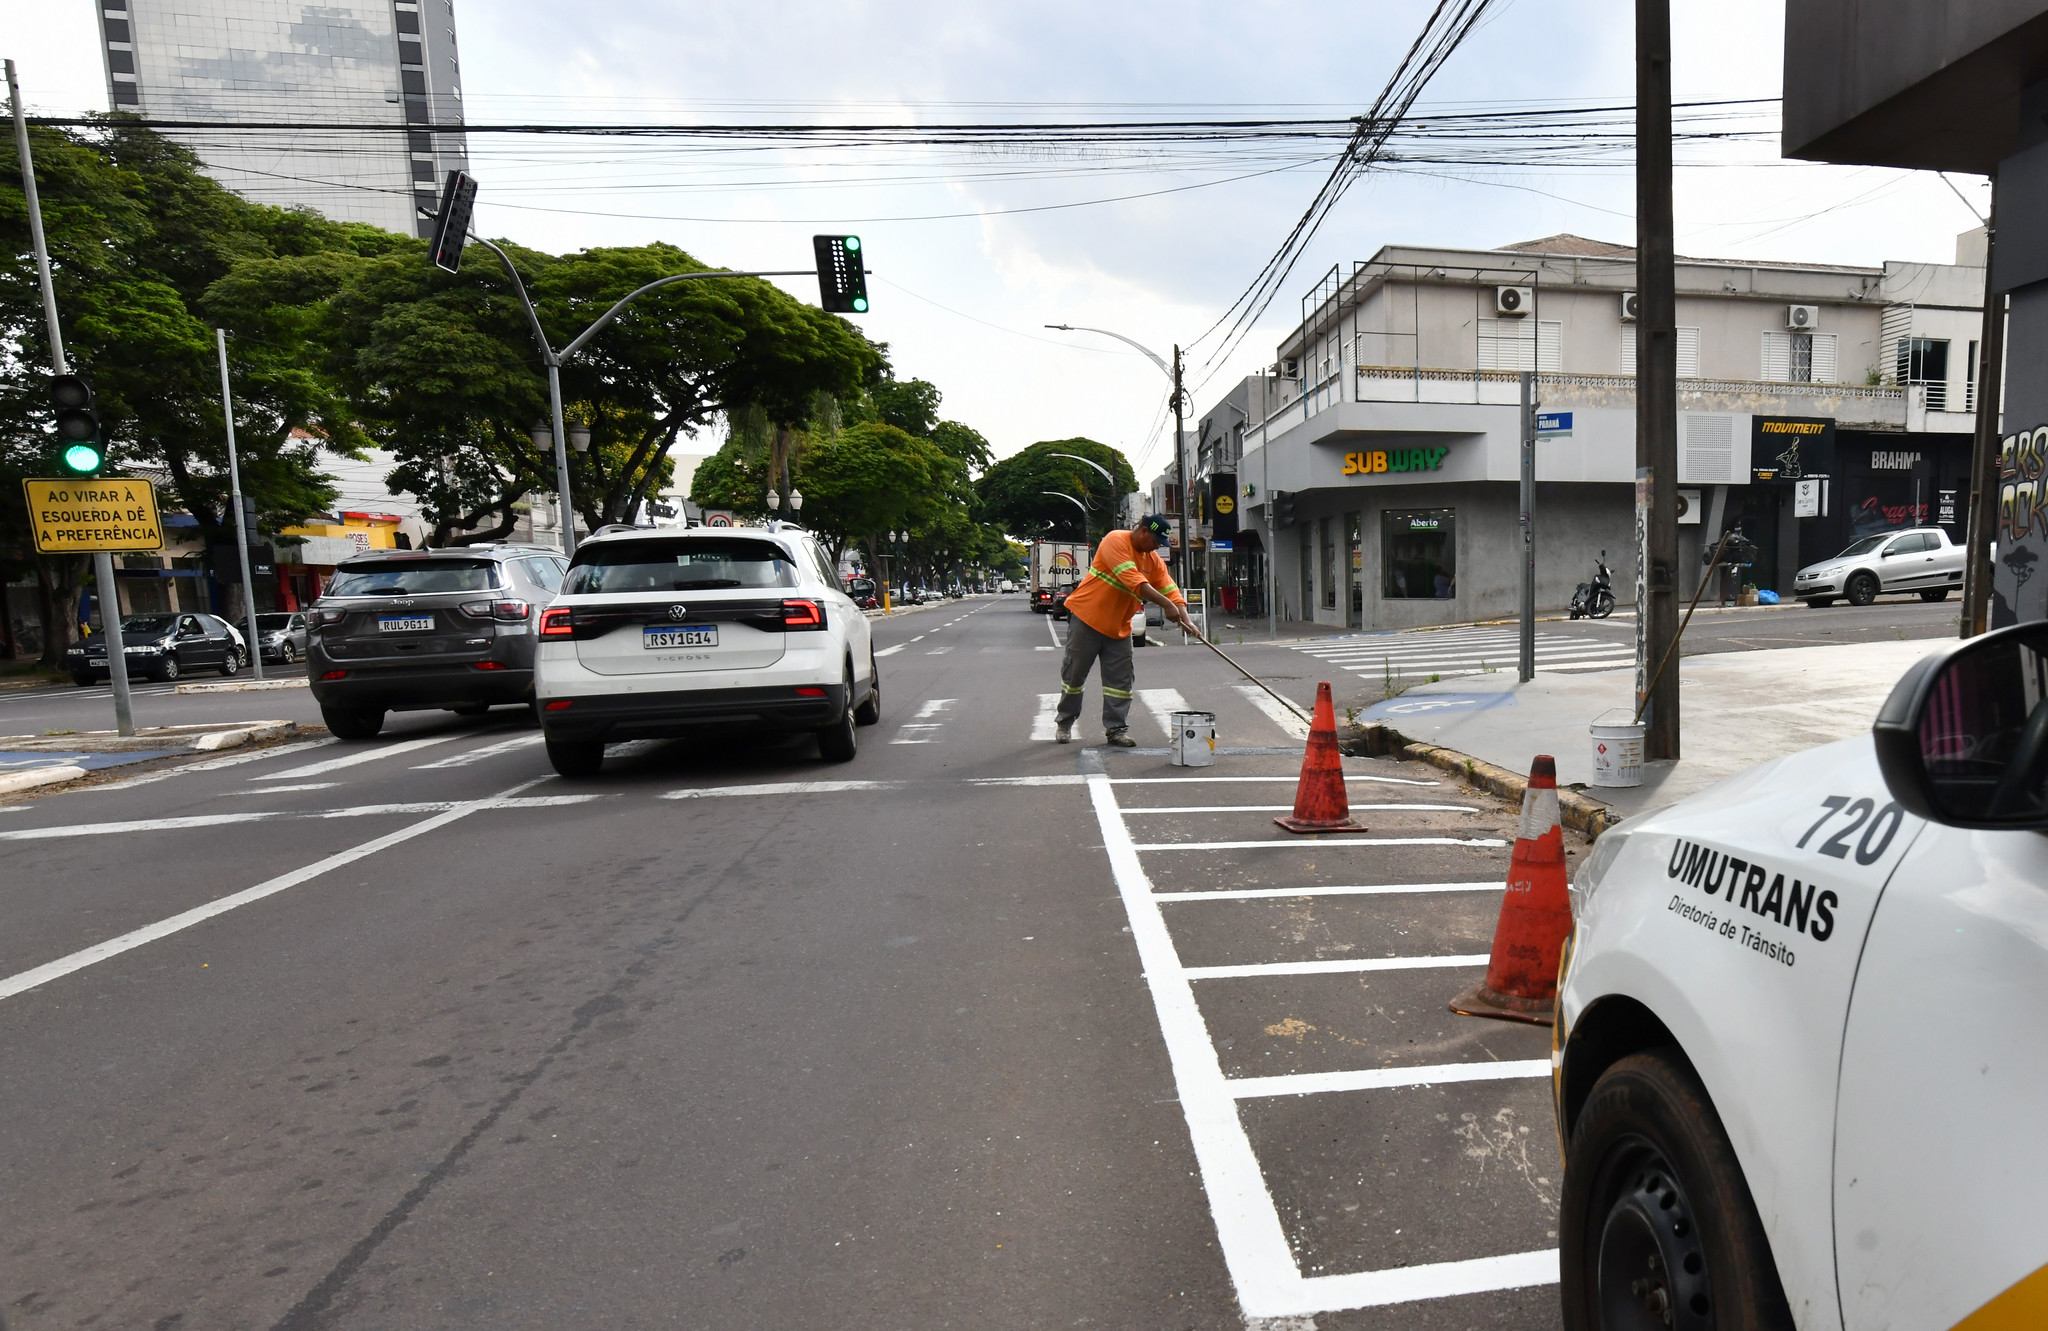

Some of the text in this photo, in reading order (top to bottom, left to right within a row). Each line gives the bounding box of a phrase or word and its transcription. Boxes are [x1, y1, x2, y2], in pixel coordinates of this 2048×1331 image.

[1762, 422, 1825, 434] MOVIMENT
[1341, 446, 1447, 476] SUBWAY
[48, 486, 135, 502] AO VIRAR À
[42, 506, 146, 523] ESQUERDA DÊ
[41, 524, 158, 542] A PREFERÊNCIA
[1048, 566, 1080, 576] Aurora
[383, 619, 429, 631] RUL9G11
[651, 632, 711, 647] RSY1G14
[1795, 795, 1904, 866] 720
[1668, 838, 1838, 942] UMUTRANS
[1668, 895, 1795, 967] Diretoria de Trânsito
